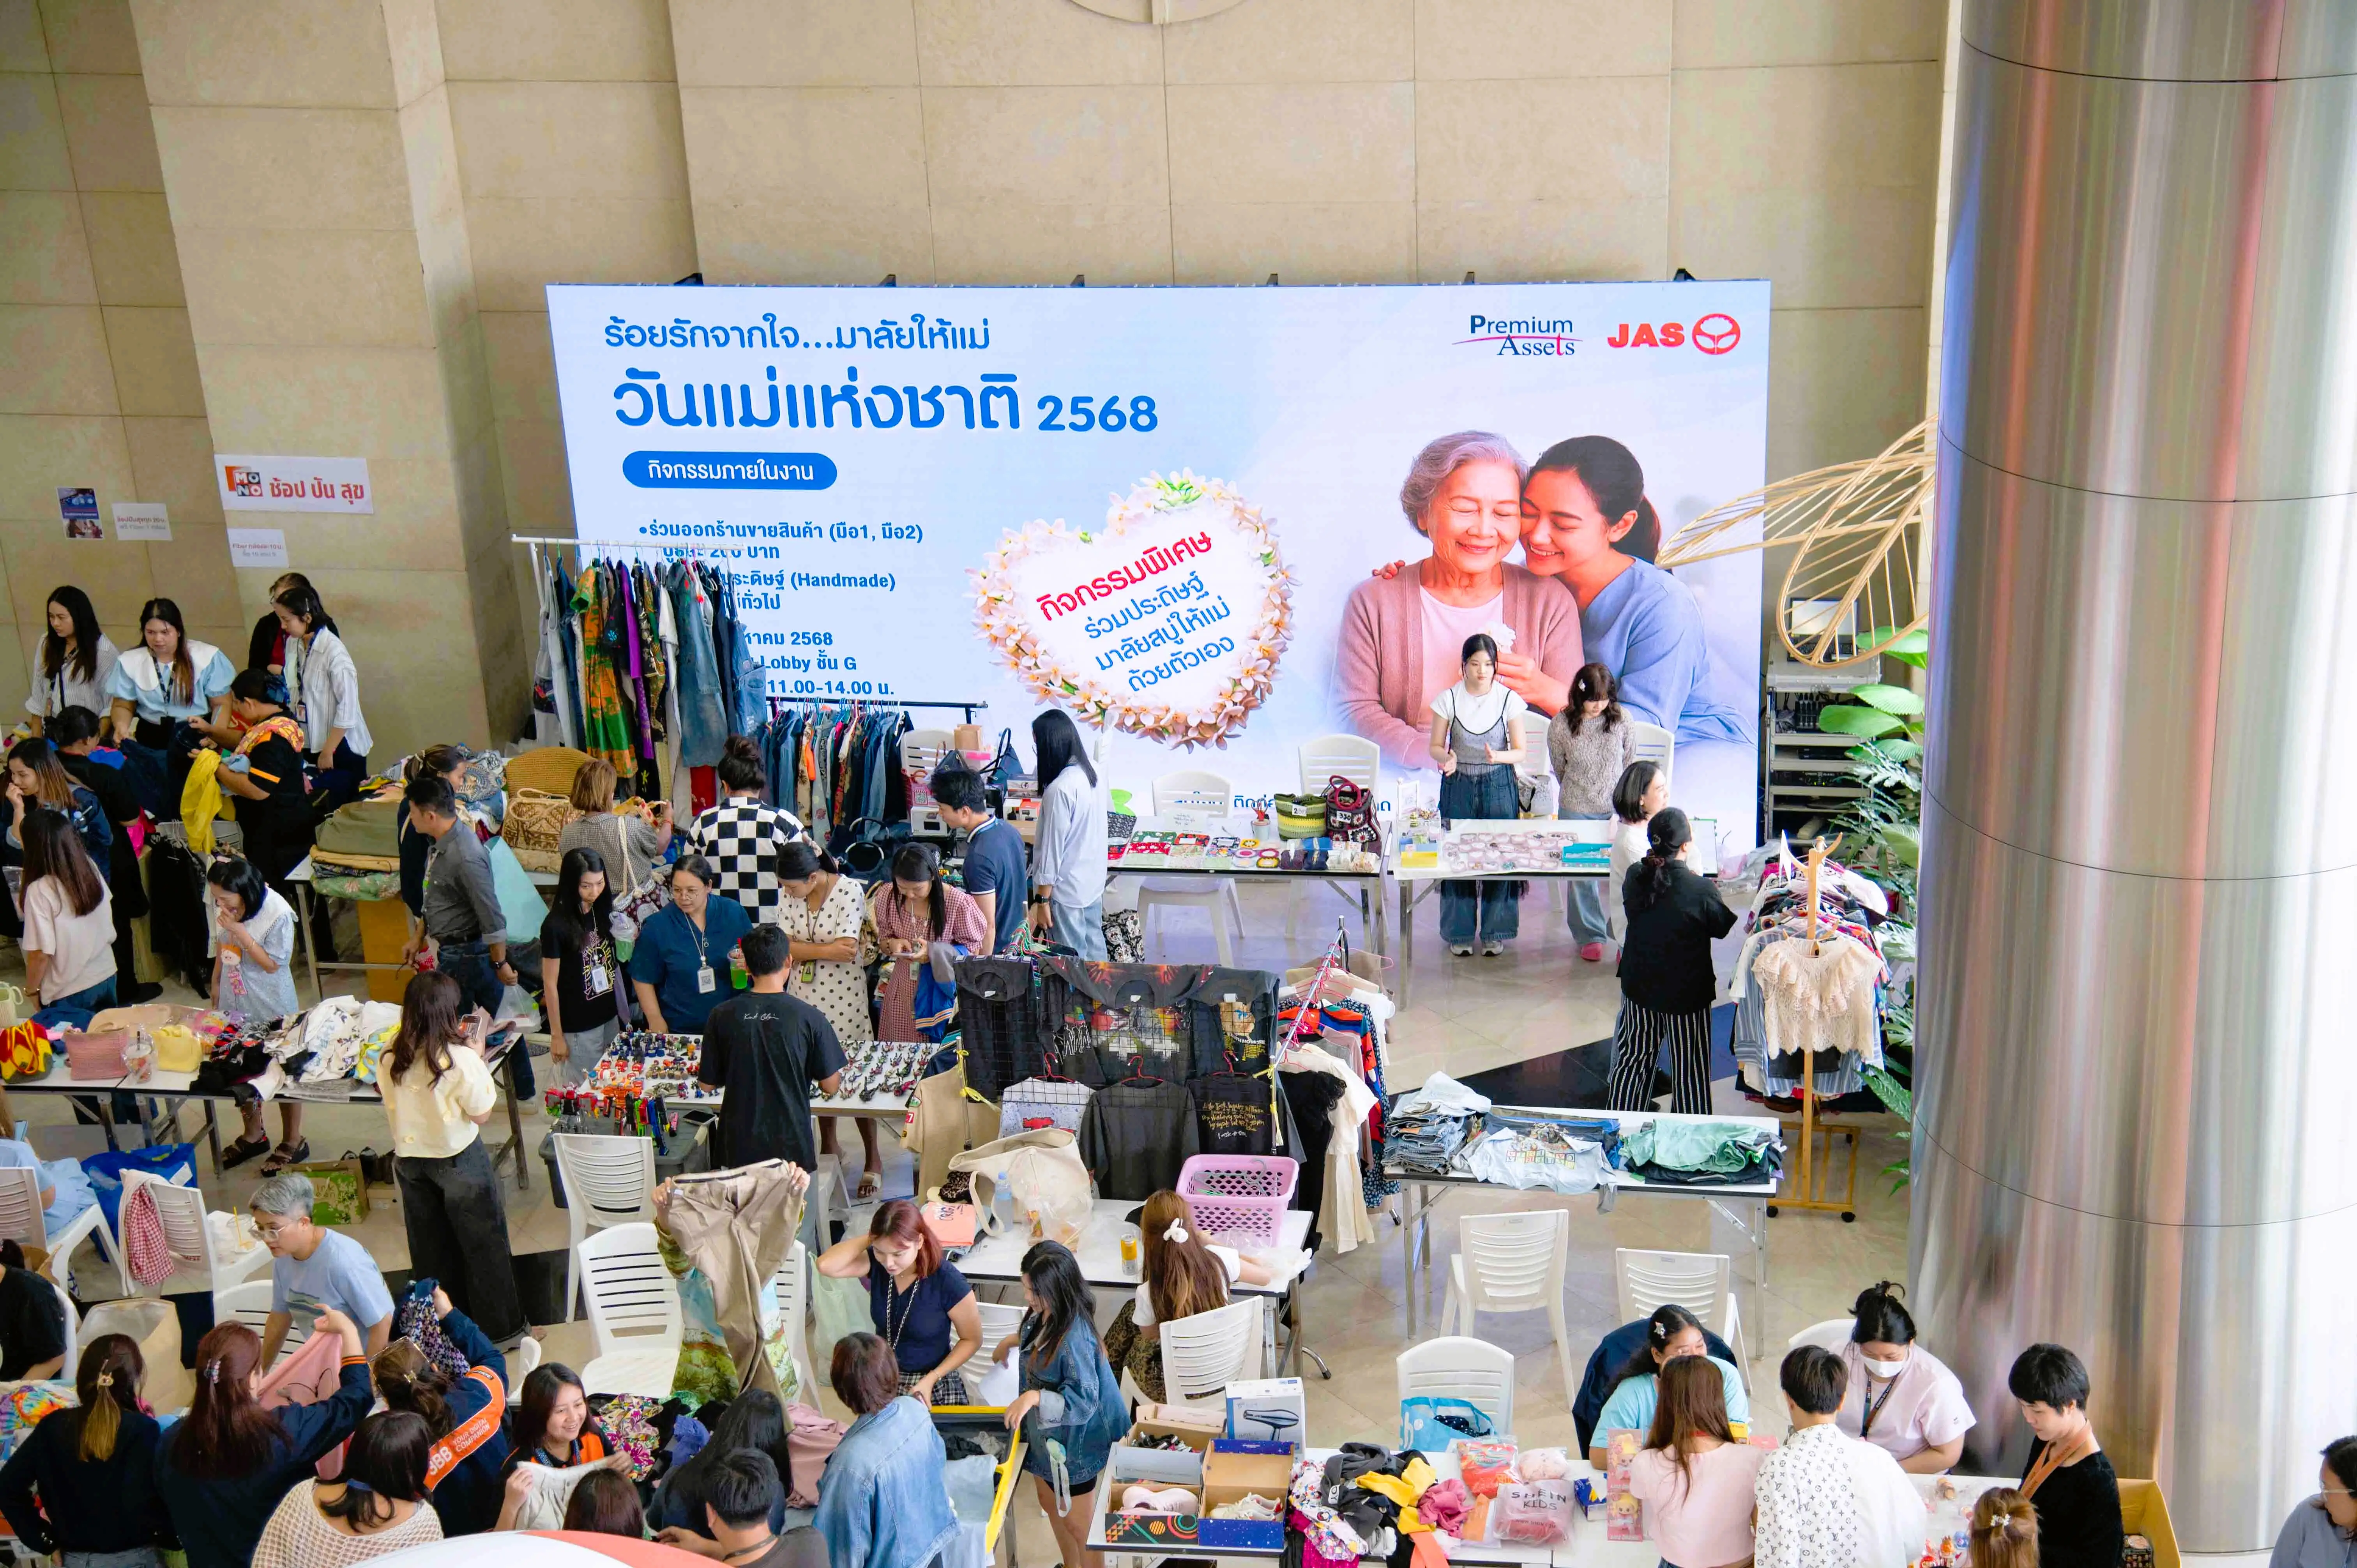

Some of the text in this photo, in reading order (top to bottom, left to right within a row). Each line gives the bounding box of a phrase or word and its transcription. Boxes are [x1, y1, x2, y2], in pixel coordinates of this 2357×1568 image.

[1470, 315, 1573, 334] Premium
[1608, 323, 1685, 348] JAS
[1497, 334, 1575, 356] Assets
[614, 366, 1158, 433] วันแม่แห่งชาติ 2568
[648, 459, 814, 480] กิจกรรมภายในงาน
[270, 477, 364, 505] ช้อป ปัน สุข
[650, 519, 823, 539] ร่วมออกร้านขายสินค้า
[747, 546, 780, 559] บาท
[791, 571, 896, 592] (Handmade)
[1036, 531, 1212, 621] กิจกรรมพิเศษ
[1084, 571, 1209, 639] ร่วมประดิษฐ์
[790, 631, 833, 646] 2568
[1095, 596, 1230, 671] มาลัยสบู่ให้แม่
[760, 650, 857, 673] Lobby ชั้น G
[1128, 635, 1235, 692] ด้วยตัวเอง
[767, 680, 894, 695] 11.00-14.00 น.
[452, 1417, 488, 1446] YOUR DIGITAL
[455, 1424, 490, 1452] COMPANION
[1511, 1489, 1566, 1503] SHEIN
[1523, 1499, 1557, 1510] KIDS
